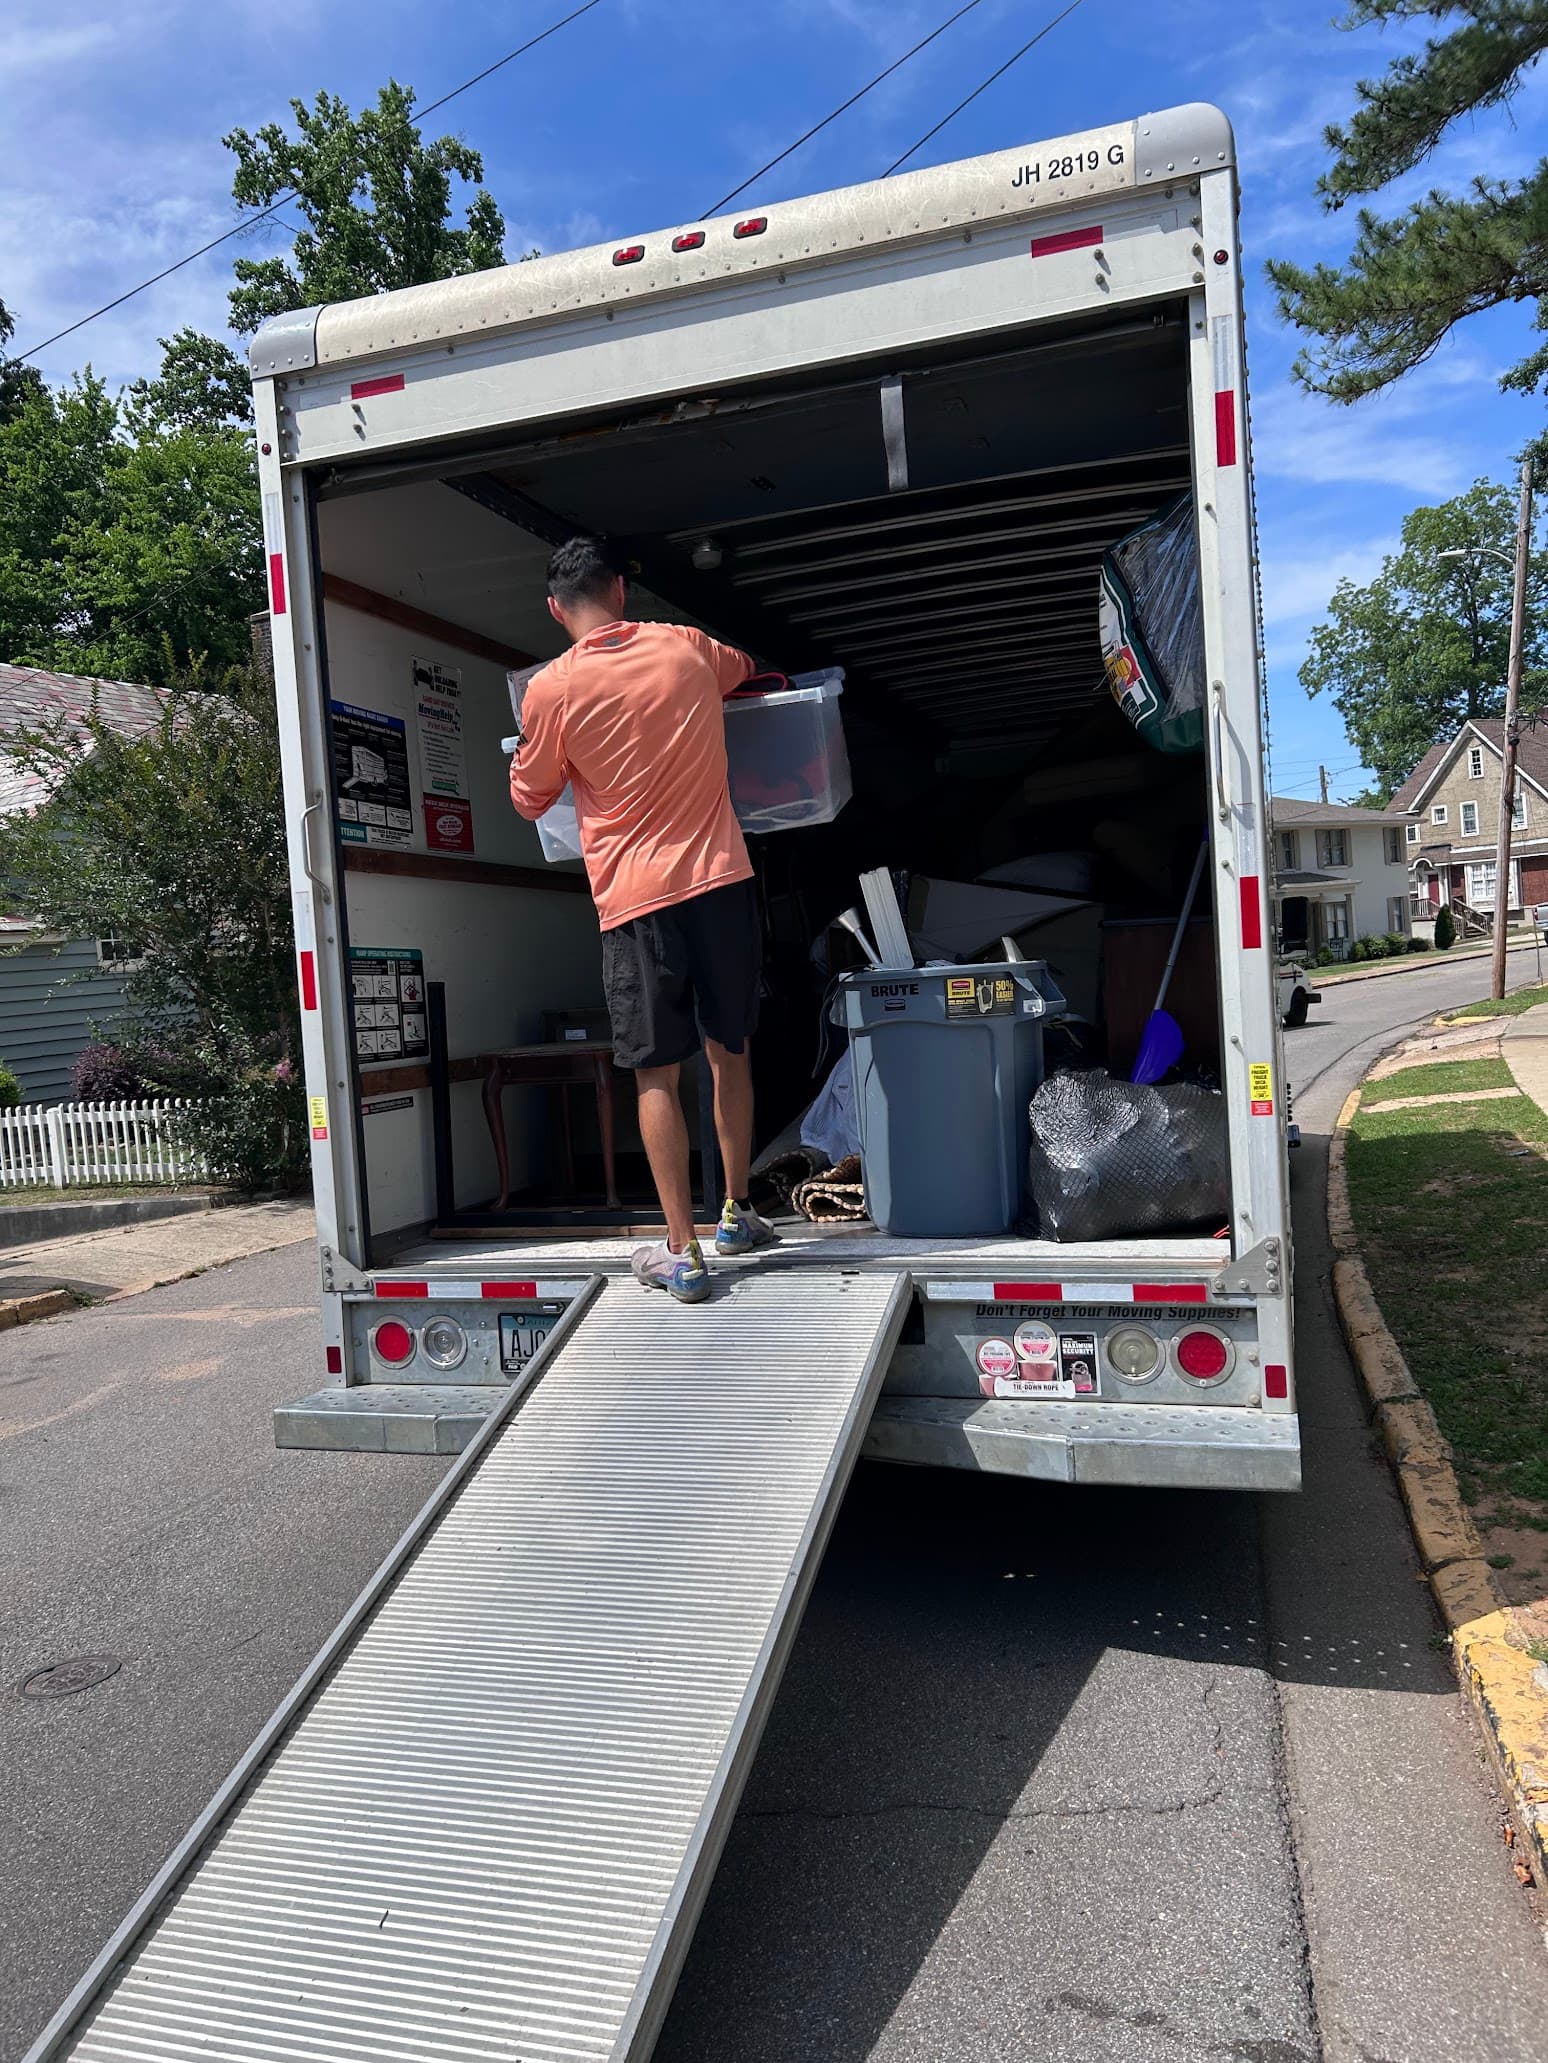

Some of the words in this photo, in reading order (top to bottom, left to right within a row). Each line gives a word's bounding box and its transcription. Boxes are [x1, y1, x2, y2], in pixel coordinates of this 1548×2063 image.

[1011, 162, 1041, 188] JH
[1048, 150, 1100, 180] 2819
[1107, 144, 1125, 165] G
[341, 827, 365, 839] TTENTION
[871, 983, 920, 998] BRUTE
[976, 1304, 1015, 1316] Don't
[1019, 1304, 1065, 1320] Forget
[1071, 1304, 1102, 1317] Your
[1108, 1305, 1162, 1320] Moving
[1168, 1306, 1241, 1320] Supplies!
[1013, 1383, 1042, 1391] TIE-DOWN
